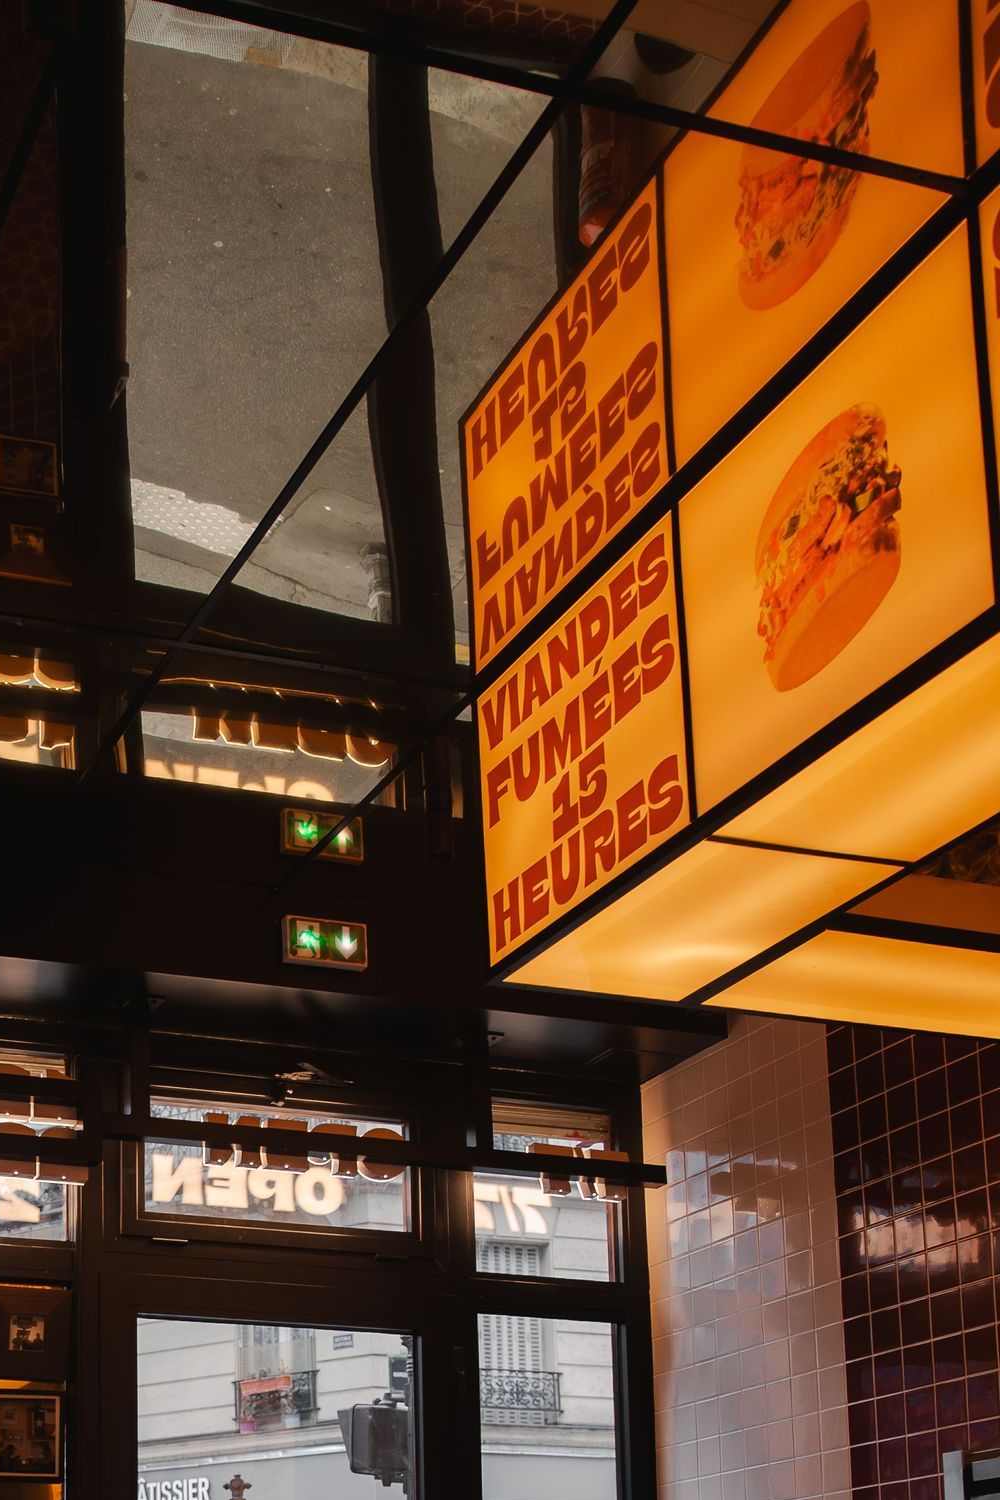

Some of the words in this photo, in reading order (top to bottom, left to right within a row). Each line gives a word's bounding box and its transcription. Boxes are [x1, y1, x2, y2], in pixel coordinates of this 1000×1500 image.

[481, 532, 669, 752] VIANDES
[485, 613, 676, 830] FUMÉES
[492, 753, 684, 954] HEURES
[552, 741, 608, 843] 15
